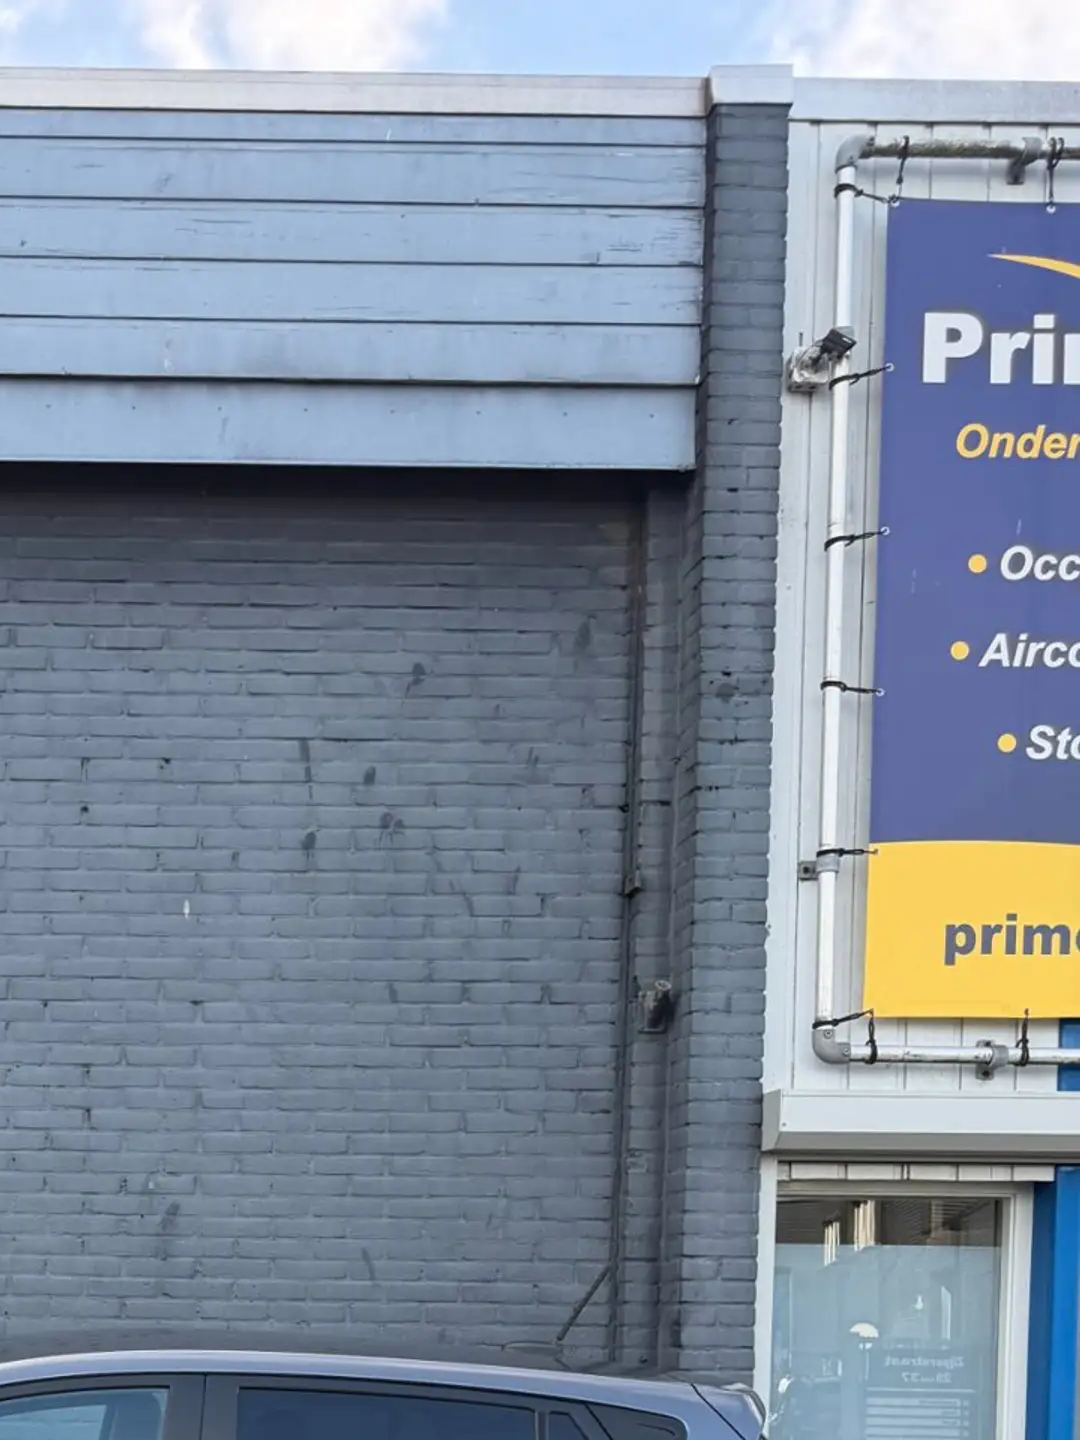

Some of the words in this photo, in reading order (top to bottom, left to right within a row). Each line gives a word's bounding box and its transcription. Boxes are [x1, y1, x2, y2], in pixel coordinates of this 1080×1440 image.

[922, 311, 1080, 385] Pri
[955, 423, 1080, 459] Onder
[1000, 545, 1080, 581] Occ
[943, 913, 1080, 966] prim
